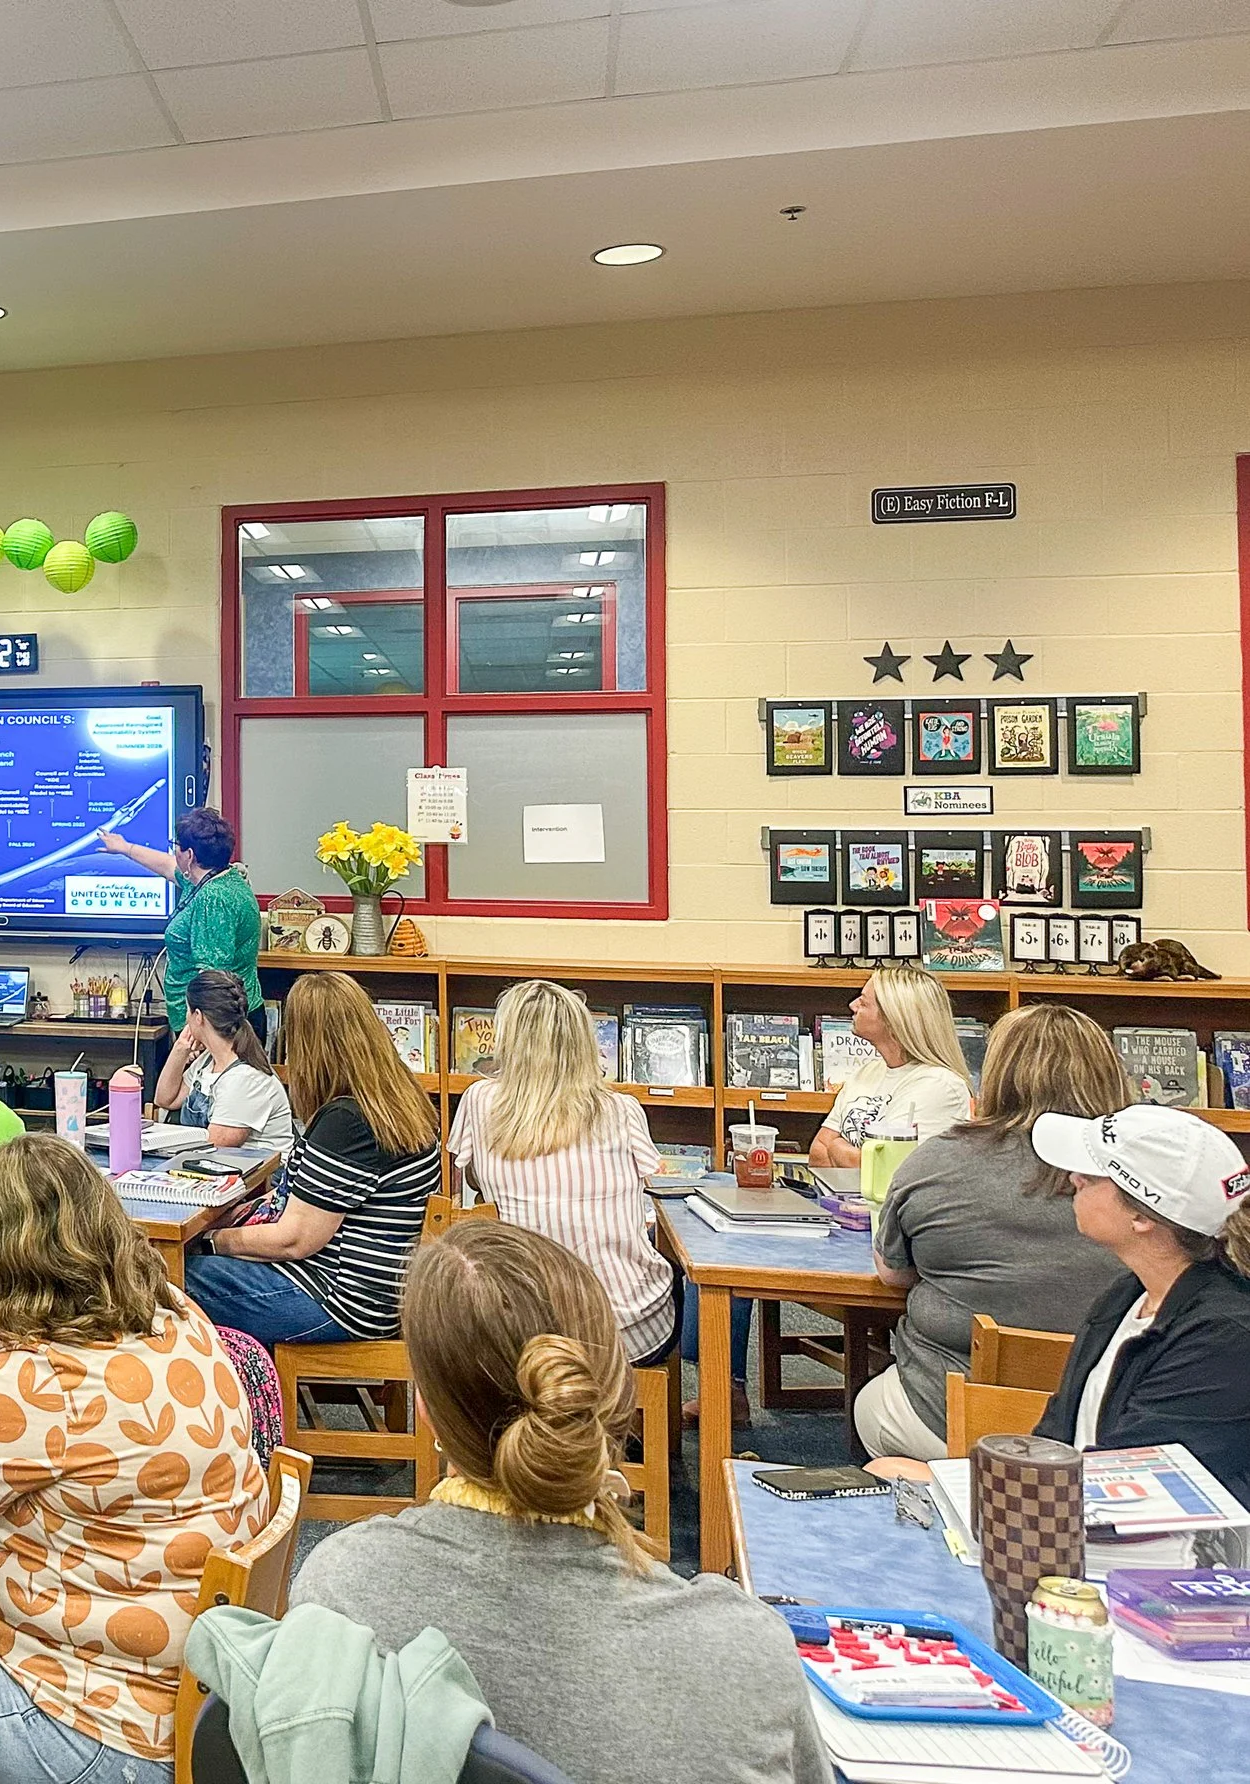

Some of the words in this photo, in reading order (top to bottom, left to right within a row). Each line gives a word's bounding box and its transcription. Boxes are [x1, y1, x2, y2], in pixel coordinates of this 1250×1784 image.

[880, 496, 900, 515] (E)
[904, 496, 934, 514] Easy
[936, 493, 981, 510] Fiction
[984, 492, 1008, 508] F-L
[1021, 714, 1043, 724] GARDEN
[861, 730, 888, 756] HUMAN
[934, 792, 961, 801] KBA
[934, 801, 987, 809] Nominees
[1014, 853, 1039, 868] BLOB
[71, 890, 108, 898] UNITED
[110, 891, 126, 899] WE
[71, 898, 161, 908] COUNCIL
[376, 1008, 393, 1016] The
[395, 1008, 419, 1017] Little
[386, 1016, 402, 1026] Red
[464, 1016, 495, 1032] THAN
[738, 1034, 755, 1043] TAR
[758, 1034, 790, 1045] BEACH
[836, 1036, 869, 1046] DRAG
[1135, 1036, 1151, 1046] THE
[1154, 1036, 1182, 1047] MOUSE
[848, 1047, 882, 1058] LOVE
[1130, 1046, 1150, 1055] WHO
[1152, 1046, 1187, 1057] CARRIED
[1142, 1056, 1148, 1065] A
[1150, 1056, 1177, 1066] HOUSE
[1134, 1064, 1145, 1074] ON
[1148, 1065, 1162, 1075] HIS
[1164, 1066, 1186, 1076] BACK
[1108, 1160, 1141, 1190] PRO
[1144, 1186, 1162, 1205] V1
[1088, 1474, 1136, 1483] FOUN
